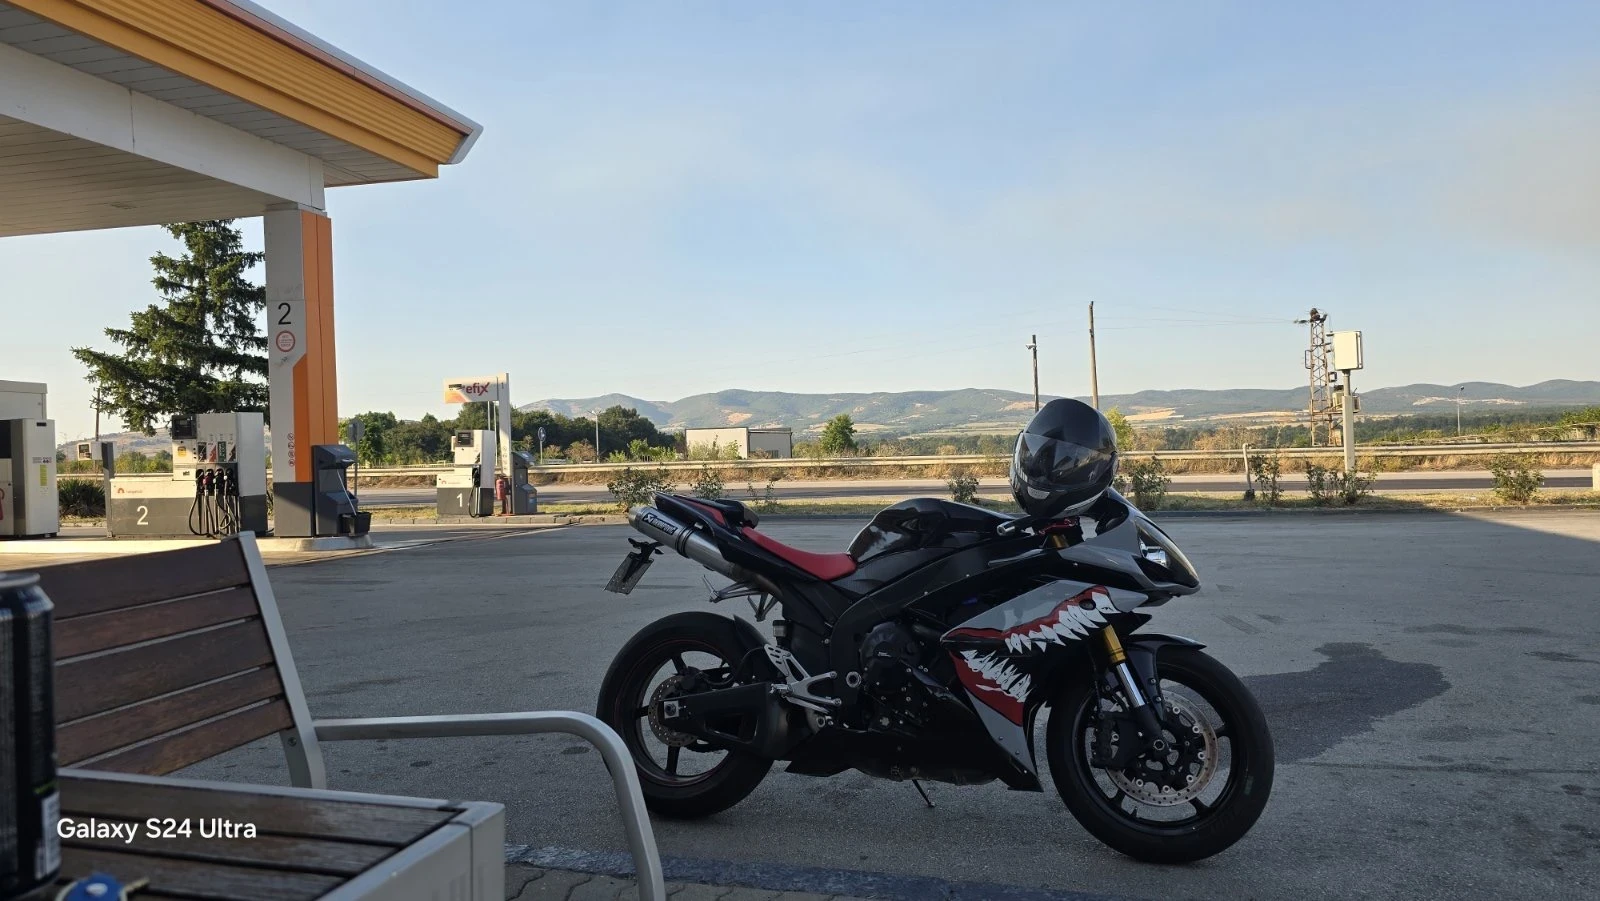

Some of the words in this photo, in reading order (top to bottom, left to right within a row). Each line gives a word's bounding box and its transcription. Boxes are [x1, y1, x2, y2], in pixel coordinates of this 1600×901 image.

[278, 302, 292, 325] 2
[466, 382, 490, 397] efix
[456, 493, 463, 508] 1
[136, 505, 149, 526] 2
